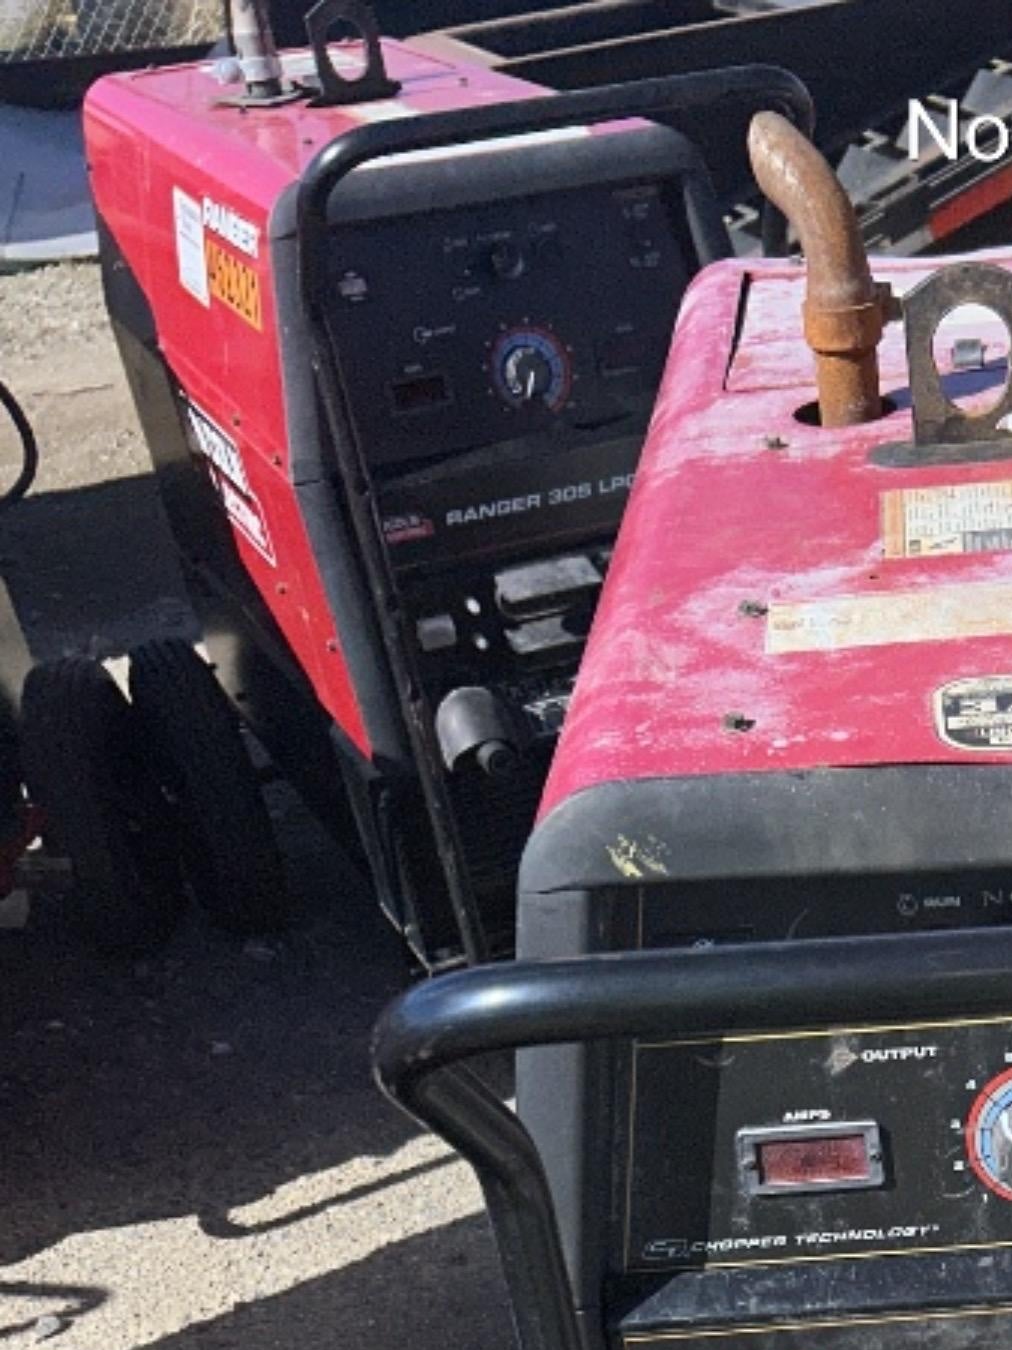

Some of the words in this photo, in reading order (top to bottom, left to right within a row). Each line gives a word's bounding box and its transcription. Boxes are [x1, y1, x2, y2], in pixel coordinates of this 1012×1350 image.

[446, 494, 541, 527] RANGER
[549, 482, 592, 505] 305
[862, 1045, 938, 1064] OUTPUT
[783, 1108, 832, 1122] AMPS
[795, 1224, 931, 1246] TECHNOLOGY
